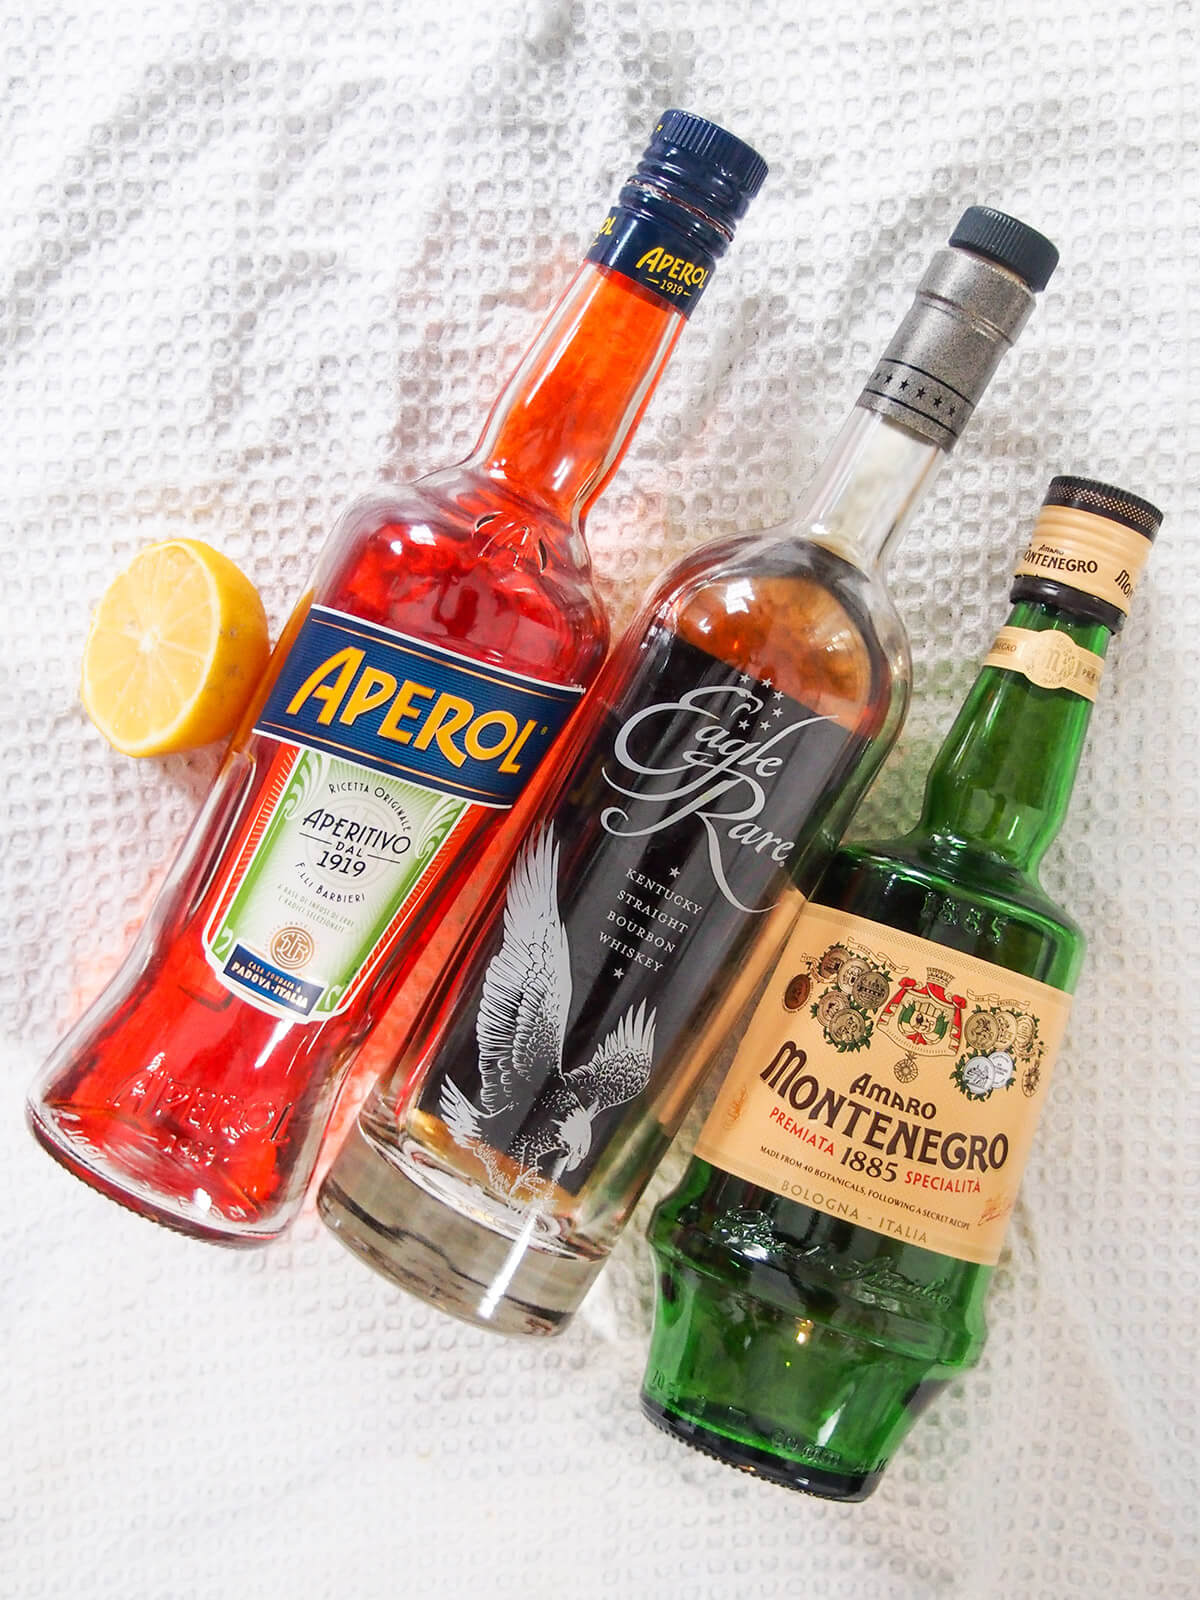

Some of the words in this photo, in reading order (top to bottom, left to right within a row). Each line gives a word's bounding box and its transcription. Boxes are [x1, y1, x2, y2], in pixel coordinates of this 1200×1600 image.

[635, 247, 709, 289] APEROL
[660, 279, 684, 296] 1919
[1023, 550, 1098, 574] ONTENEGRO
[602, 685, 839, 801] Eagle
[328, 782, 369, 795] RICETTA
[374, 787, 412, 832] ORIGINALE
[302, 808, 411, 855] APERITIVO
[335, 841, 363, 858] DAL
[600, 750, 796, 913] Rare
[295, 862, 314, 887] F.LLI
[316, 885, 365, 904] BARBIERI
[317, 851, 366, 878] 1919
[616, 889, 688, 934] STRAIGHT
[626, 868, 703, 915] KENTUCKY
[599, 931, 663, 972] WHISKEY
[606, 910, 676, 953] BOURBON
[760, 1040, 1009, 1173] MONTENEGRO
[768, 1106, 834, 1157] PREMIATA
[840, 1146, 898, 1183] 1885
[760, 1145, 780, 1159] MADE
[780, 1154, 803, 1169] FROM
[803, 1165, 814, 1174] 40
[814, 1168, 867, 1196] BOTANICALS,
[868, 1189, 915, 1212] FOLLOWING
[922, 1208, 948, 1223] SECRET
[781, 1180, 859, 1220] BOLOGNA
[878, 1216, 928, 1243] ITALIA
